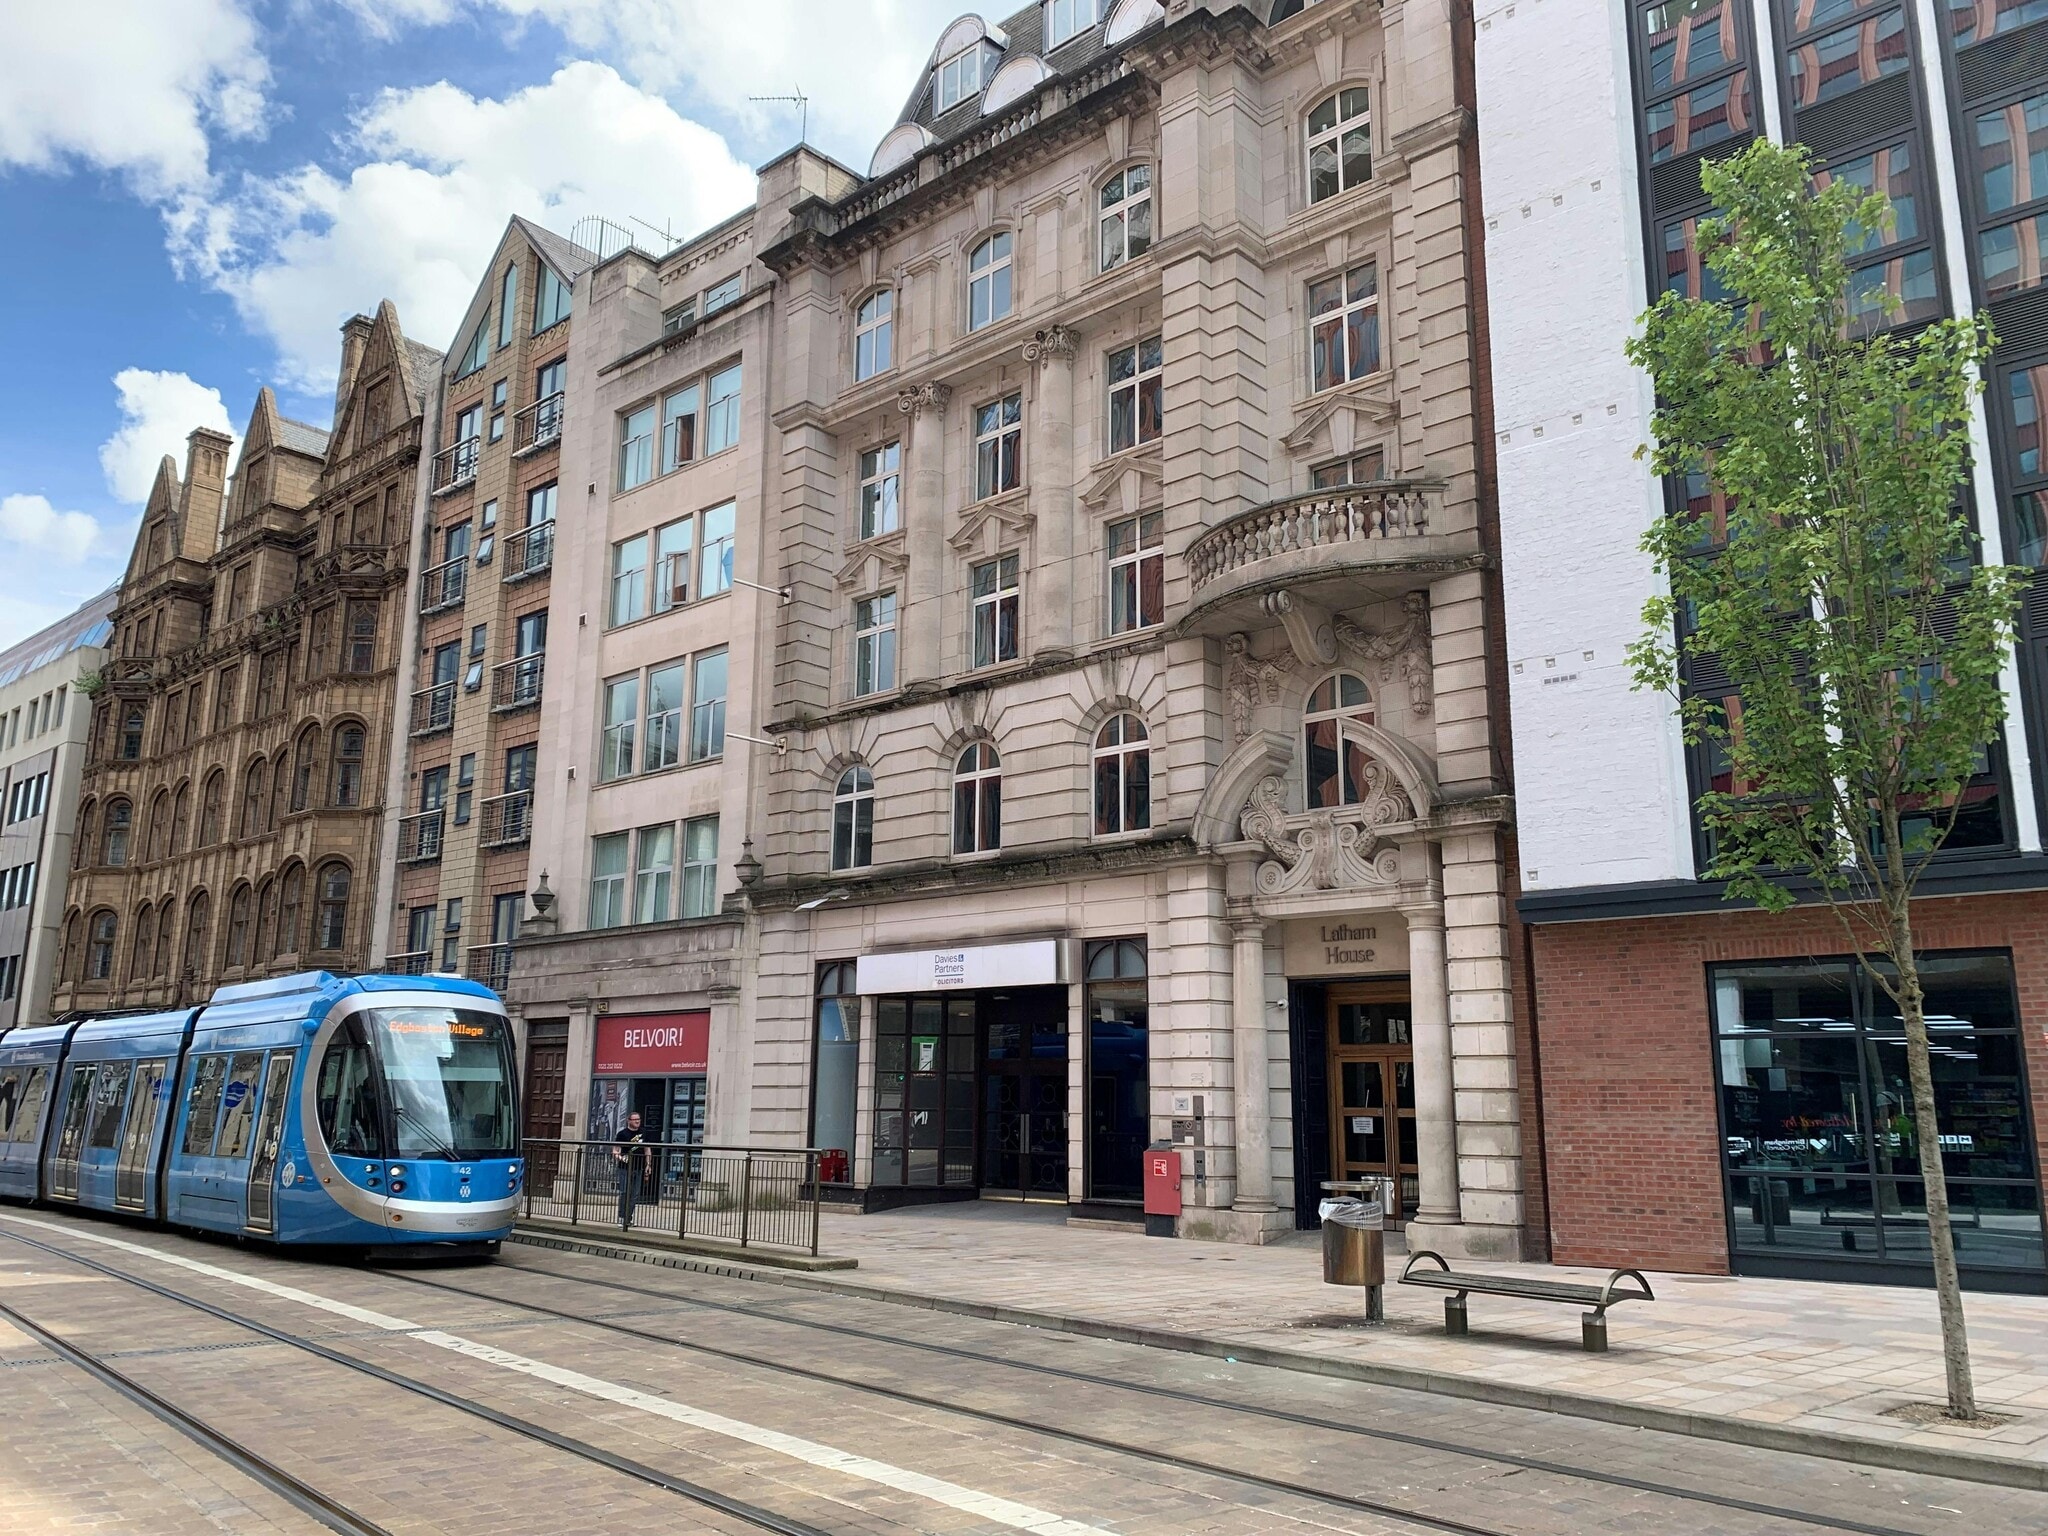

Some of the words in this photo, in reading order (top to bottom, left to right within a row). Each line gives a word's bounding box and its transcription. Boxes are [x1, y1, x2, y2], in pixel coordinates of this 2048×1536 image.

[1321, 923, 1377, 942] Latham
[934, 954, 958, 964] Davies
[1325, 946, 1375, 965] House
[934, 964, 965, 974] Partners
[935, 977, 964, 985] OLICITORS
[624, 1027, 683, 1049] BELVOIR!
[459, 1166, 472, 1175] 42
